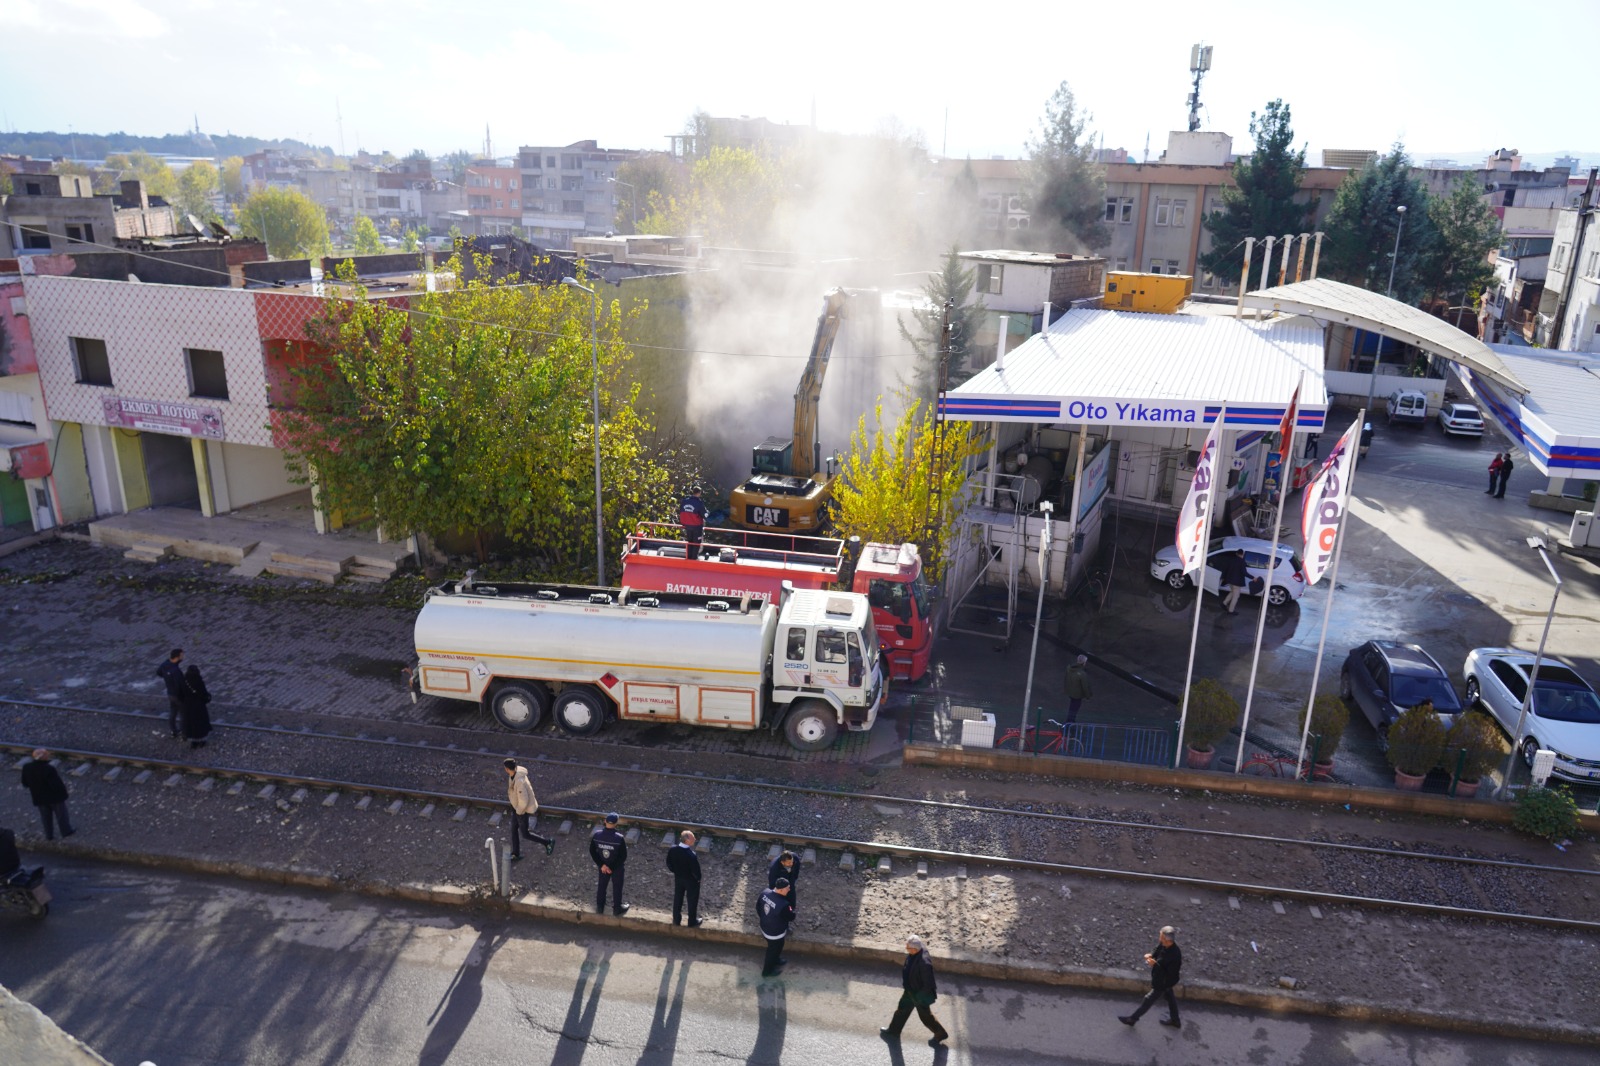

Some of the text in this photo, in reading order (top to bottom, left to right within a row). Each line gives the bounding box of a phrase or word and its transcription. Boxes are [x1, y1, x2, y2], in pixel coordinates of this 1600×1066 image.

[120, 400, 158, 415] EKMEN
[160, 405, 199, 420] MOTOR
[1068, 400, 1197, 422] Oto Yıkama
[753, 506, 780, 525] CAT
[666, 583, 708, 595] BATMAN
[784, 662, 809, 670] 2520
